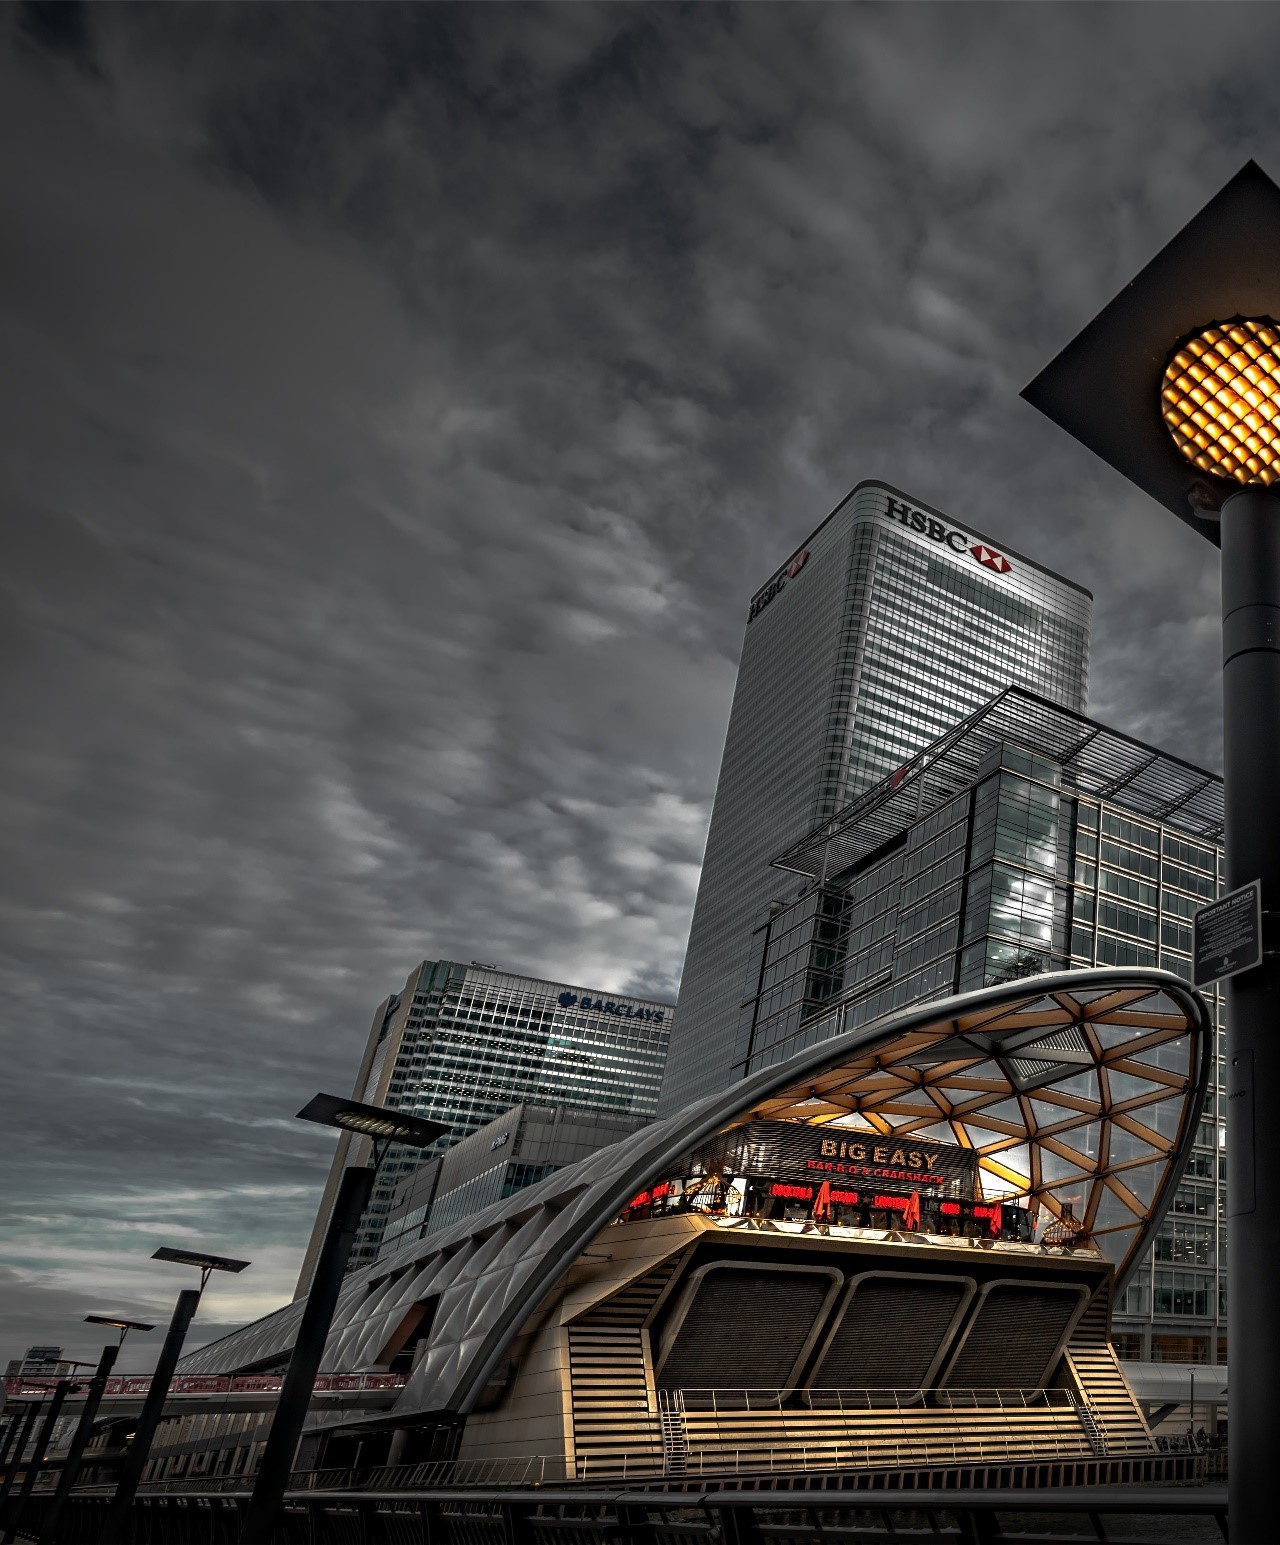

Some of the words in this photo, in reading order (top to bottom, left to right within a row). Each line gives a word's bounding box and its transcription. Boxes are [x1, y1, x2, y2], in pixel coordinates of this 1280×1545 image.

[884, 496, 969, 554] HSBC
[1197, 901, 1231, 921] IMPORTANT
[1232, 890, 1254, 906] NOTICE
[580, 996, 665, 1023] BARCLAYS
[820, 1139, 866, 1161] BIG
[873, 1146, 939, 1170] EASY
[873, 1168, 944, 1185] CRABSHACK
